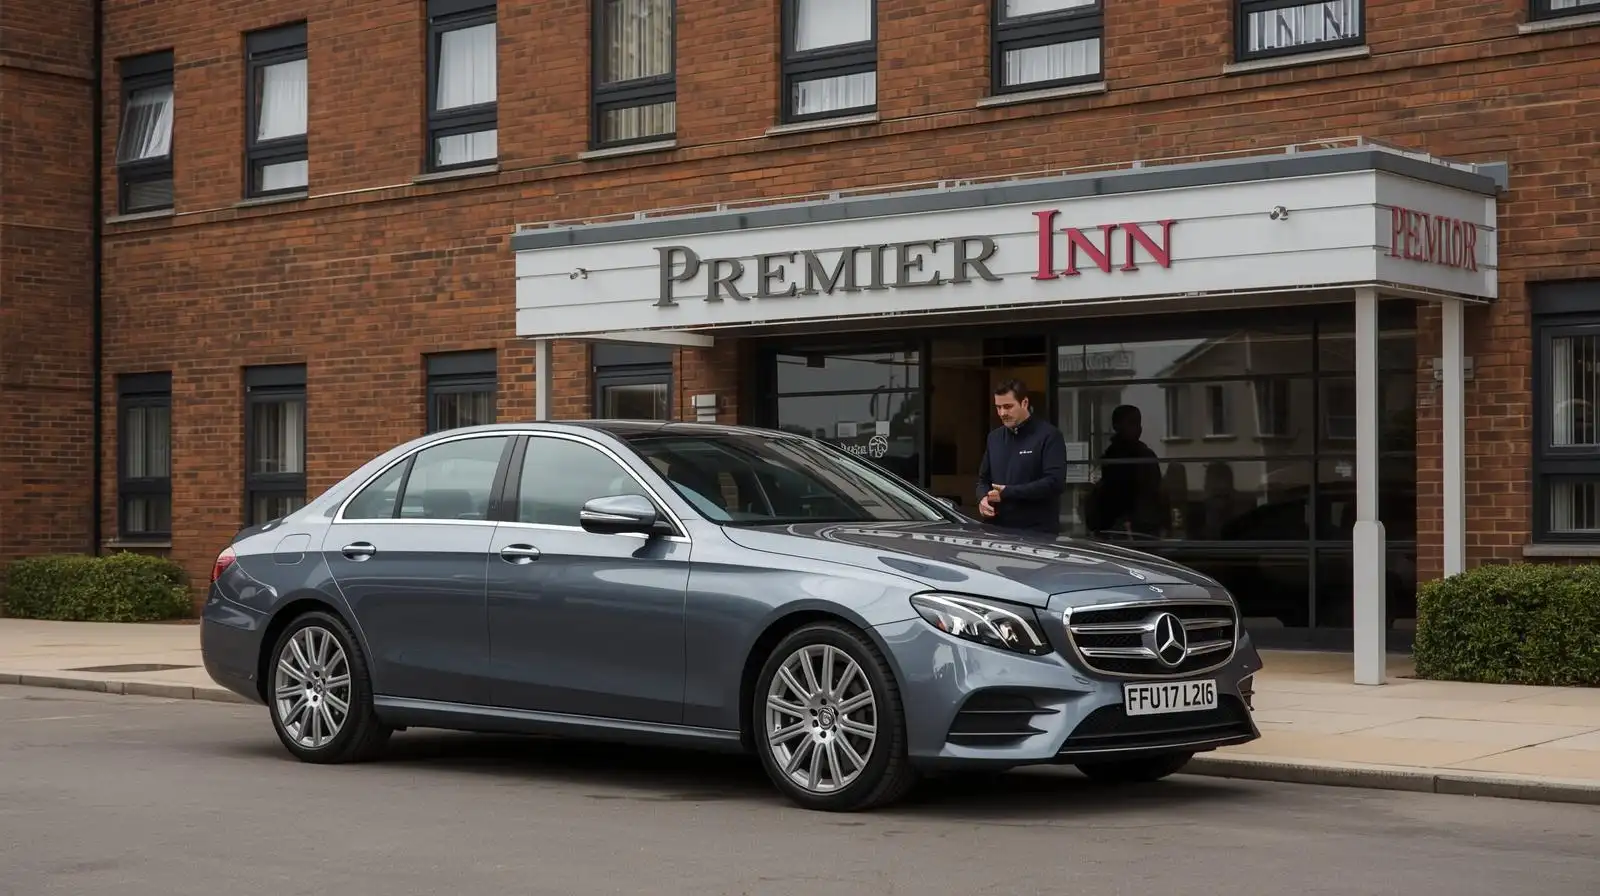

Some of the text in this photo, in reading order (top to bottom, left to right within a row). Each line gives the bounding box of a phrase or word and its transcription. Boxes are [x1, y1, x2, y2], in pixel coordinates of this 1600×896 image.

[653, 208, 1177, 307] PREMIER INN
[1128, 685, 1179, 710] FFU17
